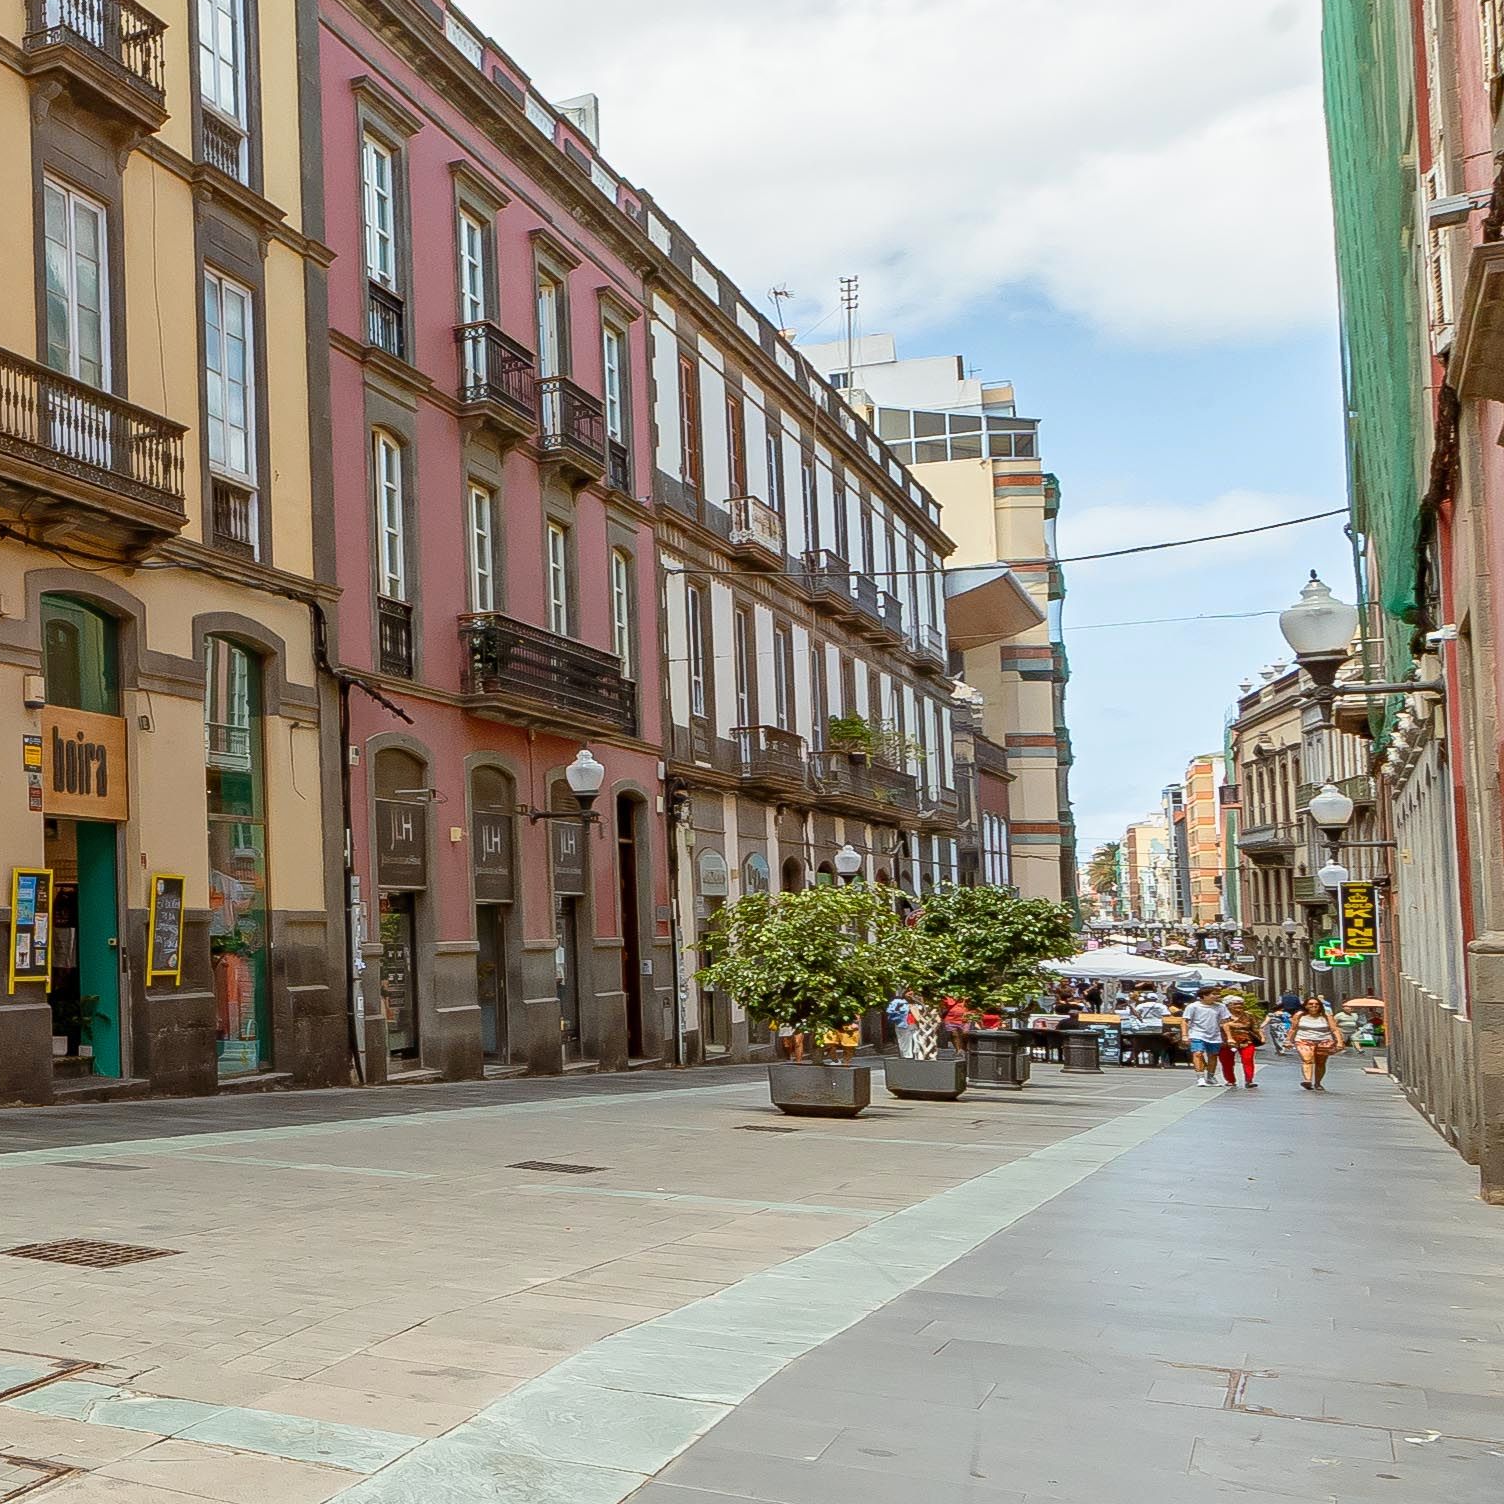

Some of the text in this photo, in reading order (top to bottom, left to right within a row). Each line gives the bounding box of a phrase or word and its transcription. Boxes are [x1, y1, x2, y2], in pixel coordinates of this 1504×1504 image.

[52, 725, 107, 797] boira
[482, 824, 501, 862] JLH
[560, 829, 576, 863] JLH
[1344, 909, 1374, 946] KING
